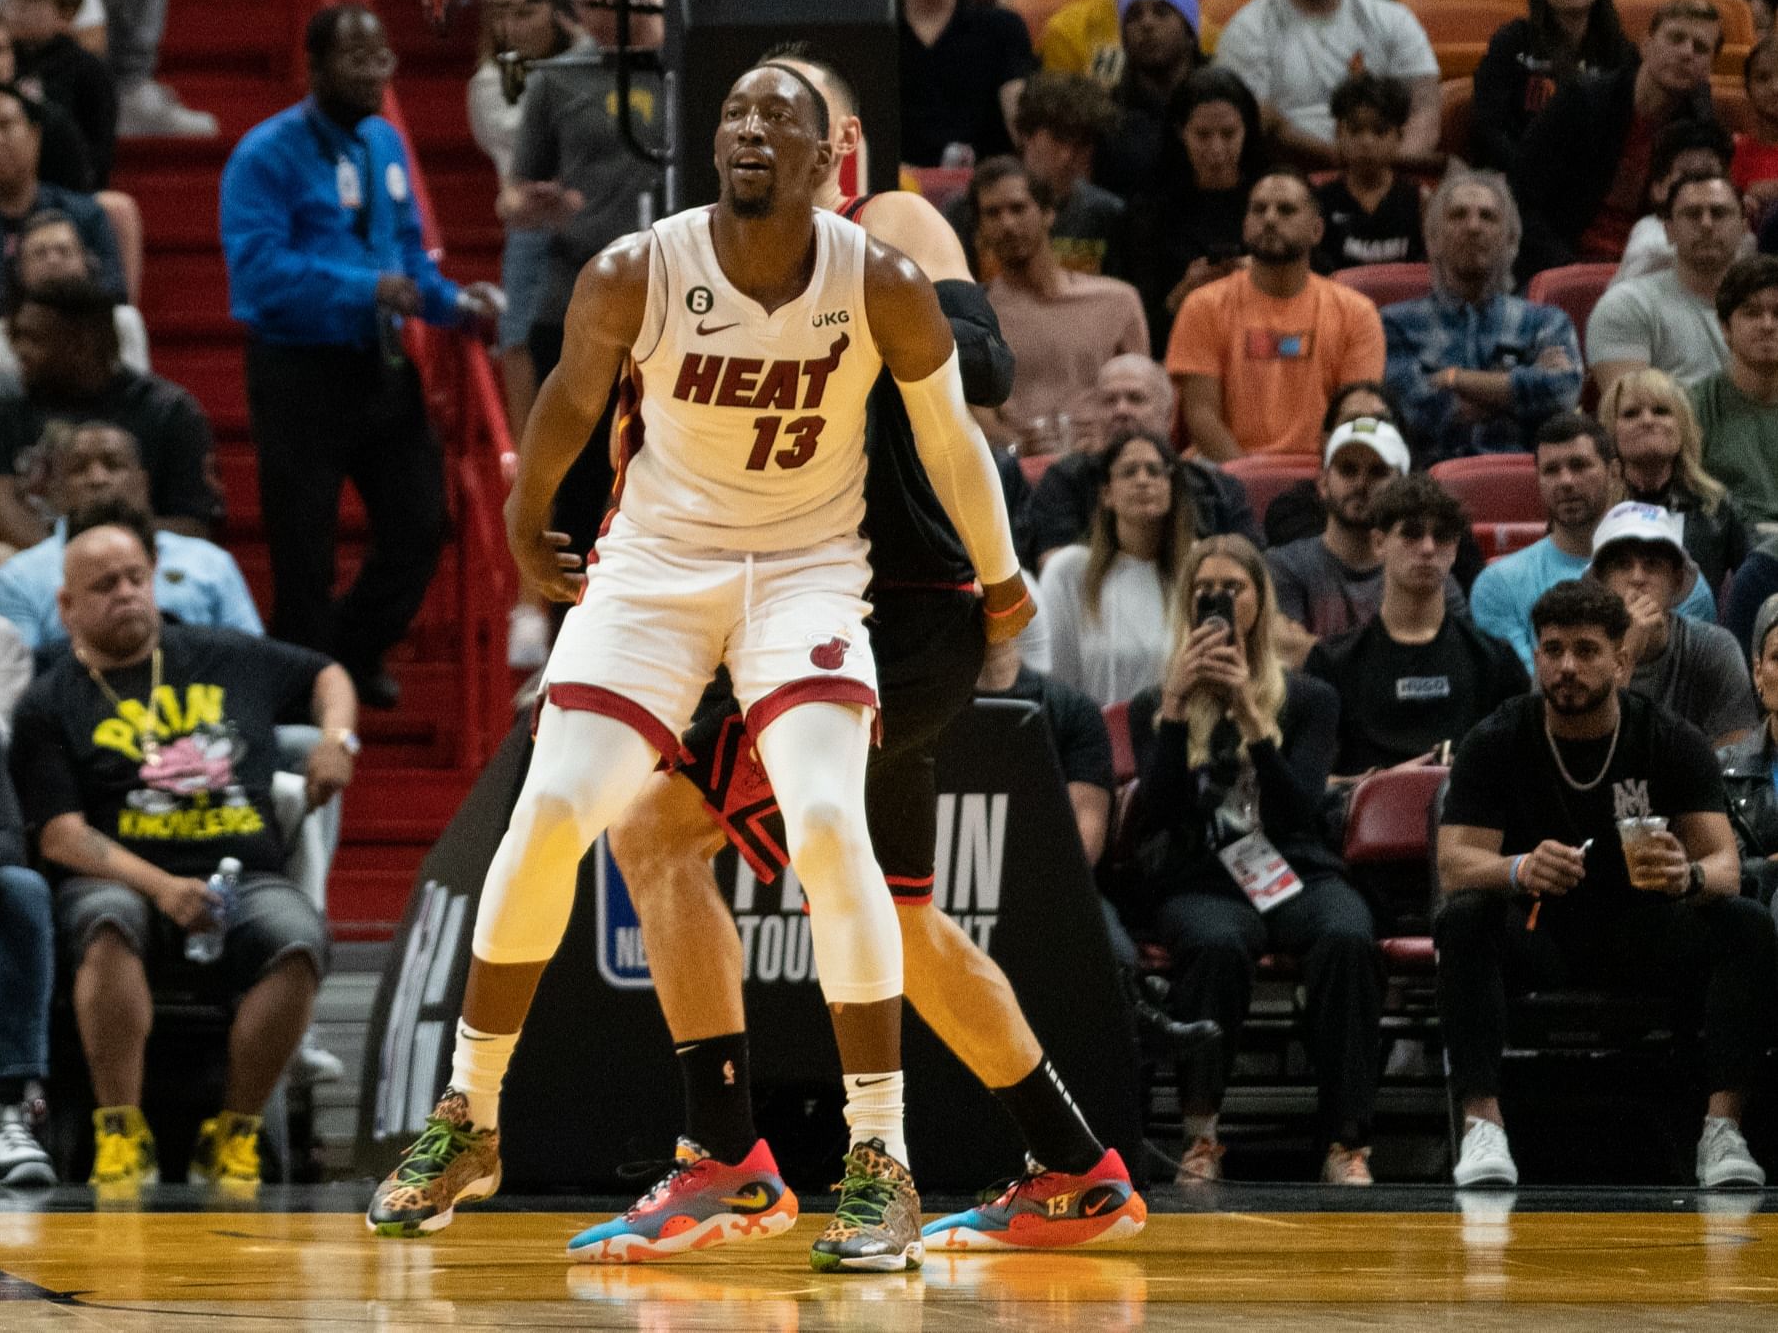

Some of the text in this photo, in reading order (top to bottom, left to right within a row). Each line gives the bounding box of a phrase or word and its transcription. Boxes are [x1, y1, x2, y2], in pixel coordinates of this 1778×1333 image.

[690, 288, 709, 312] 6
[672, 330, 851, 411] HEAT
[744, 414, 828, 472] 13
[1045, 1192, 1070, 1218] 13
